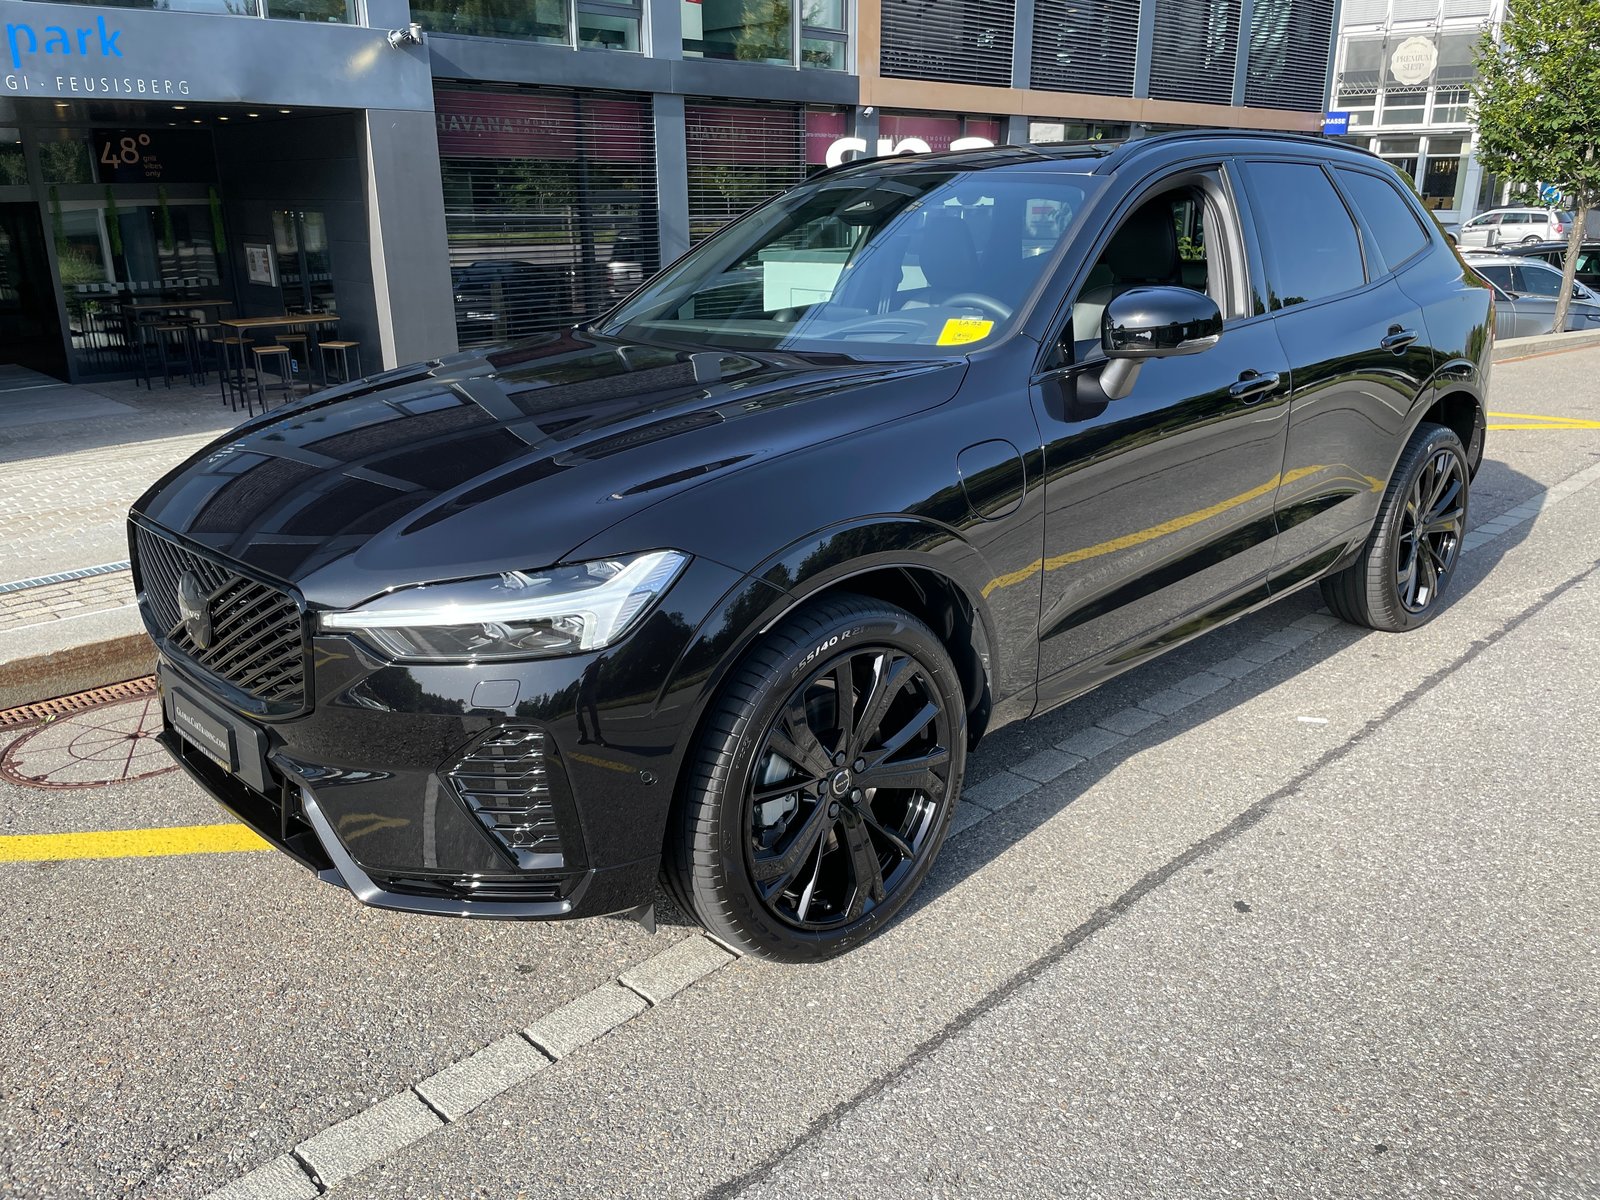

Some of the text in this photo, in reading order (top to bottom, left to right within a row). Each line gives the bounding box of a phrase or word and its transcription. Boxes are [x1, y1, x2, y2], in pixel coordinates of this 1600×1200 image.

[6, 15, 124, 69] park
[1396, 54, 1432, 63] PREMIUM
[5, 75, 190, 95] GI FEUSISBERG
[145, 169, 161, 177] only
[790, 636, 838, 680] 255/40
